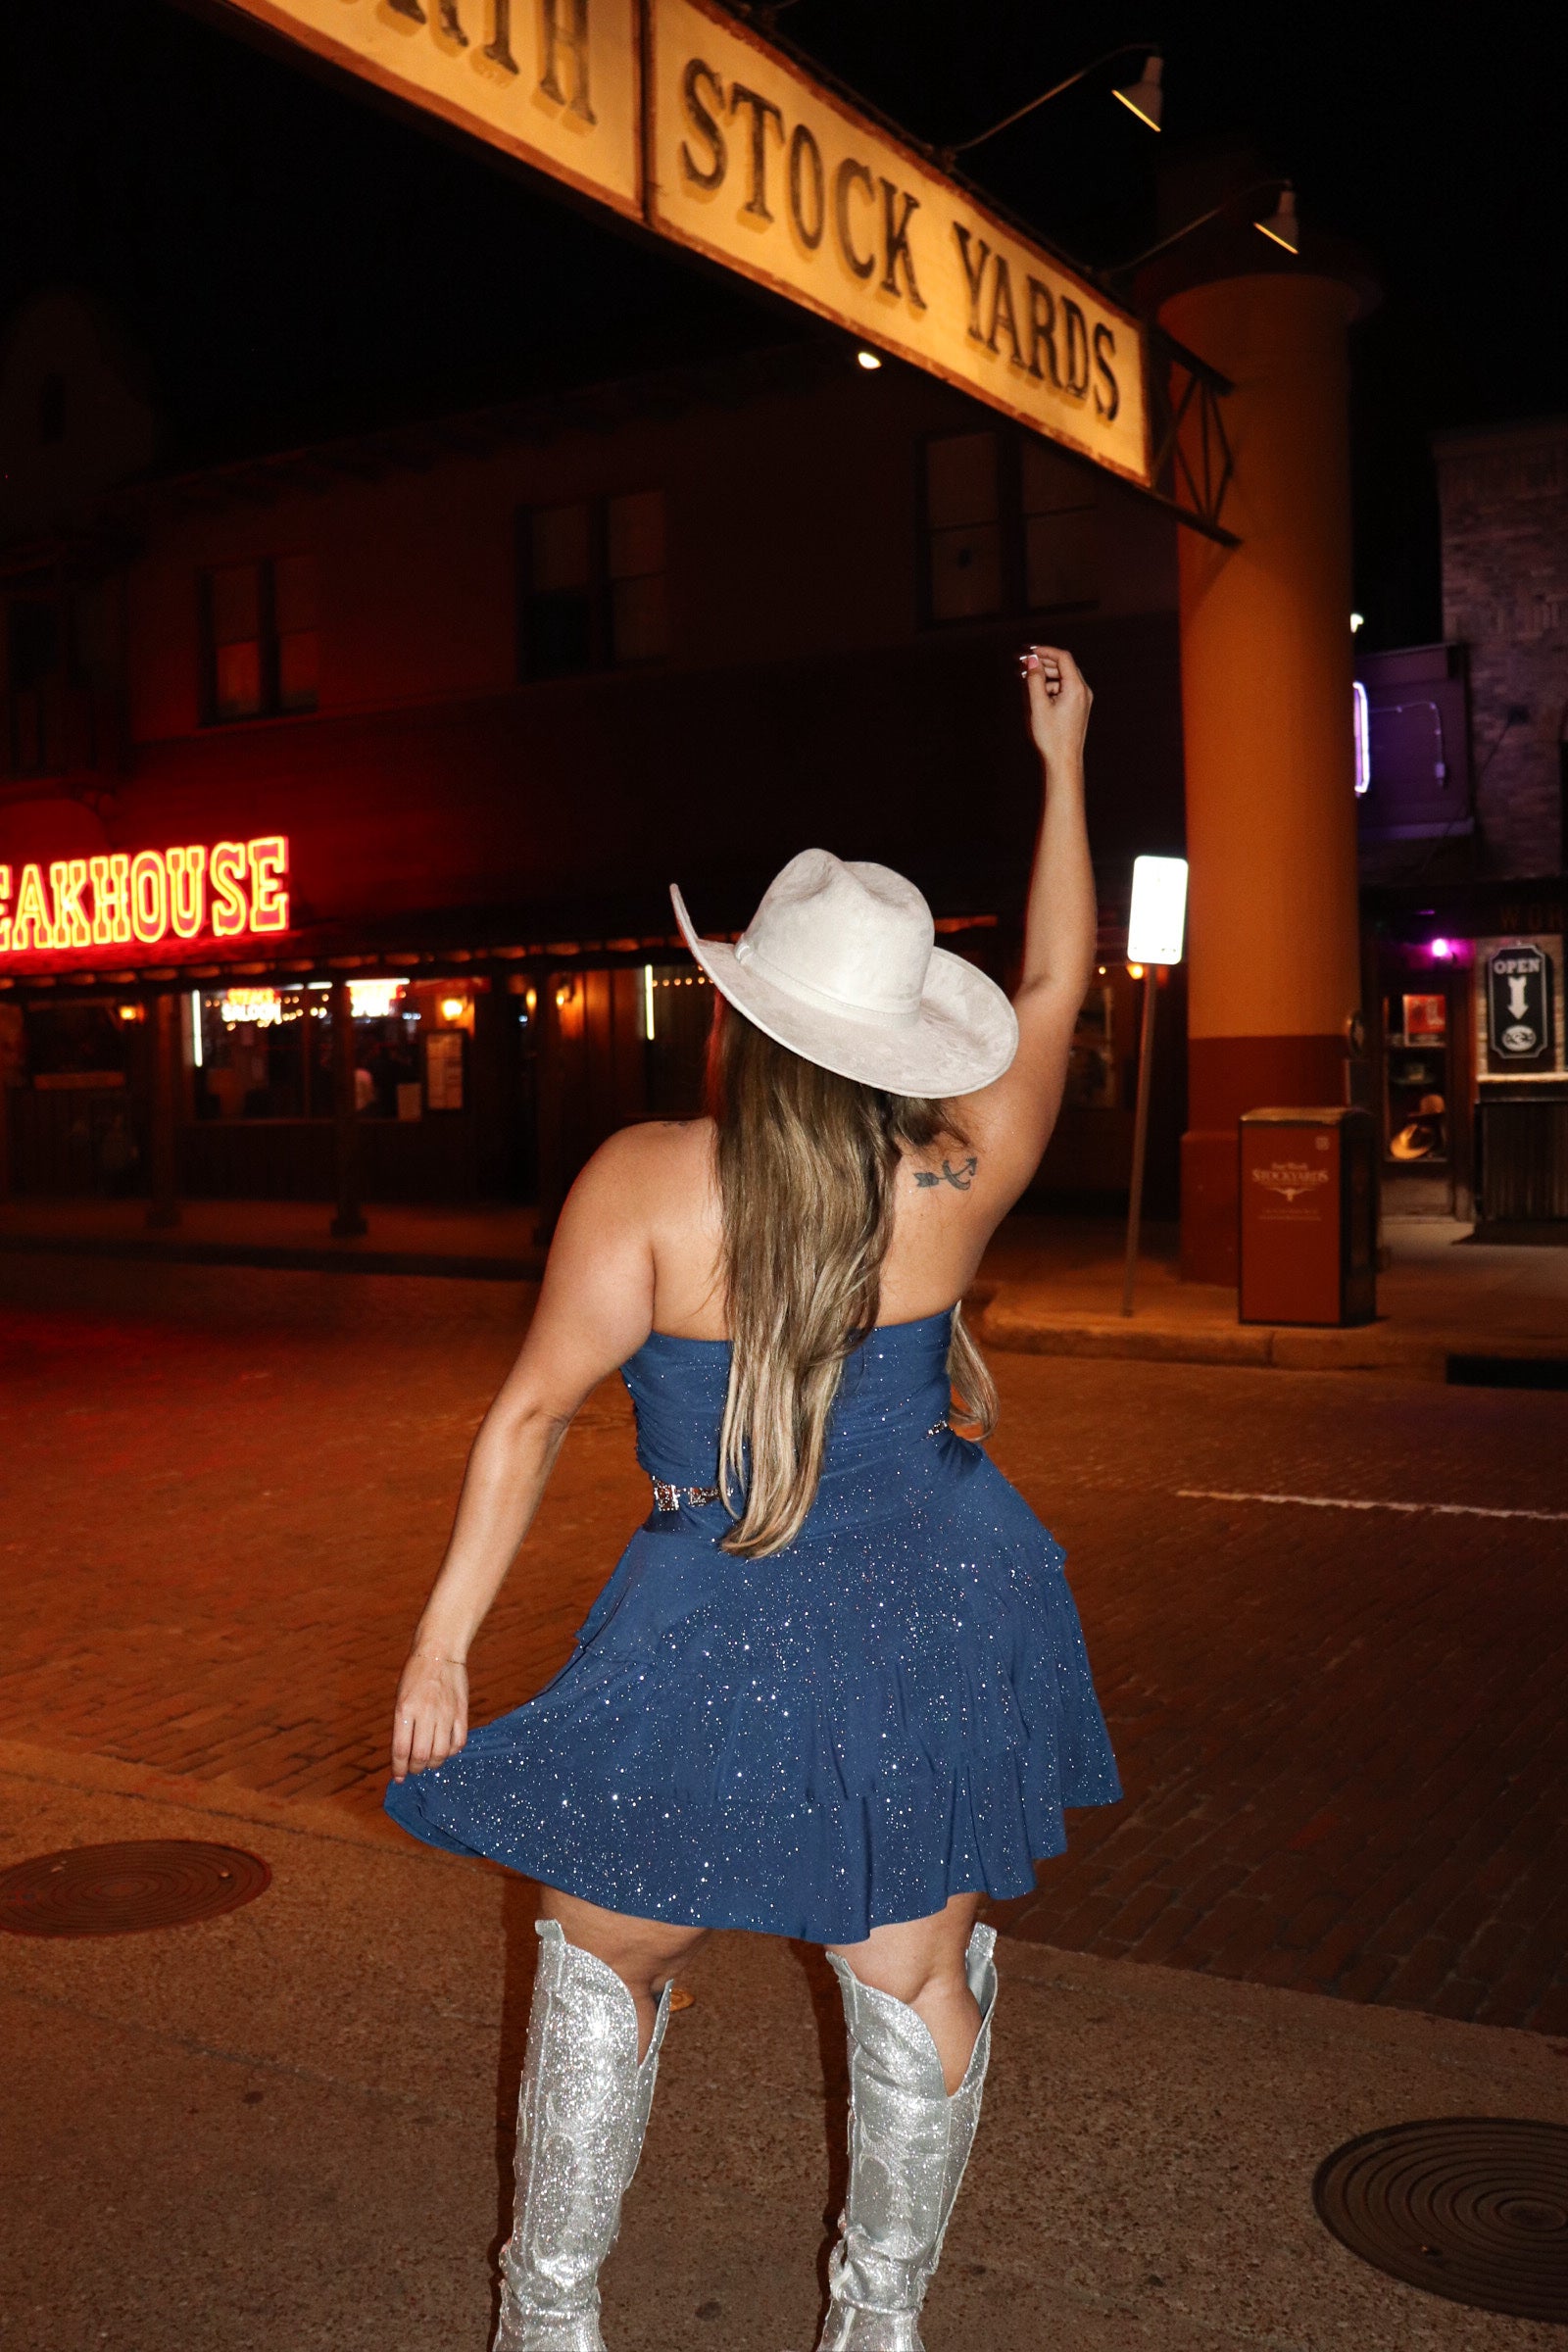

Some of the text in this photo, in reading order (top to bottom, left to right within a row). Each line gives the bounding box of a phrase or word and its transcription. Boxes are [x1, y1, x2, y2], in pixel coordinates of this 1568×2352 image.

[682, 58, 927, 311] STOCK
[953, 221, 1120, 422] YARDS
[1493, 957, 1542, 975] OPEN
